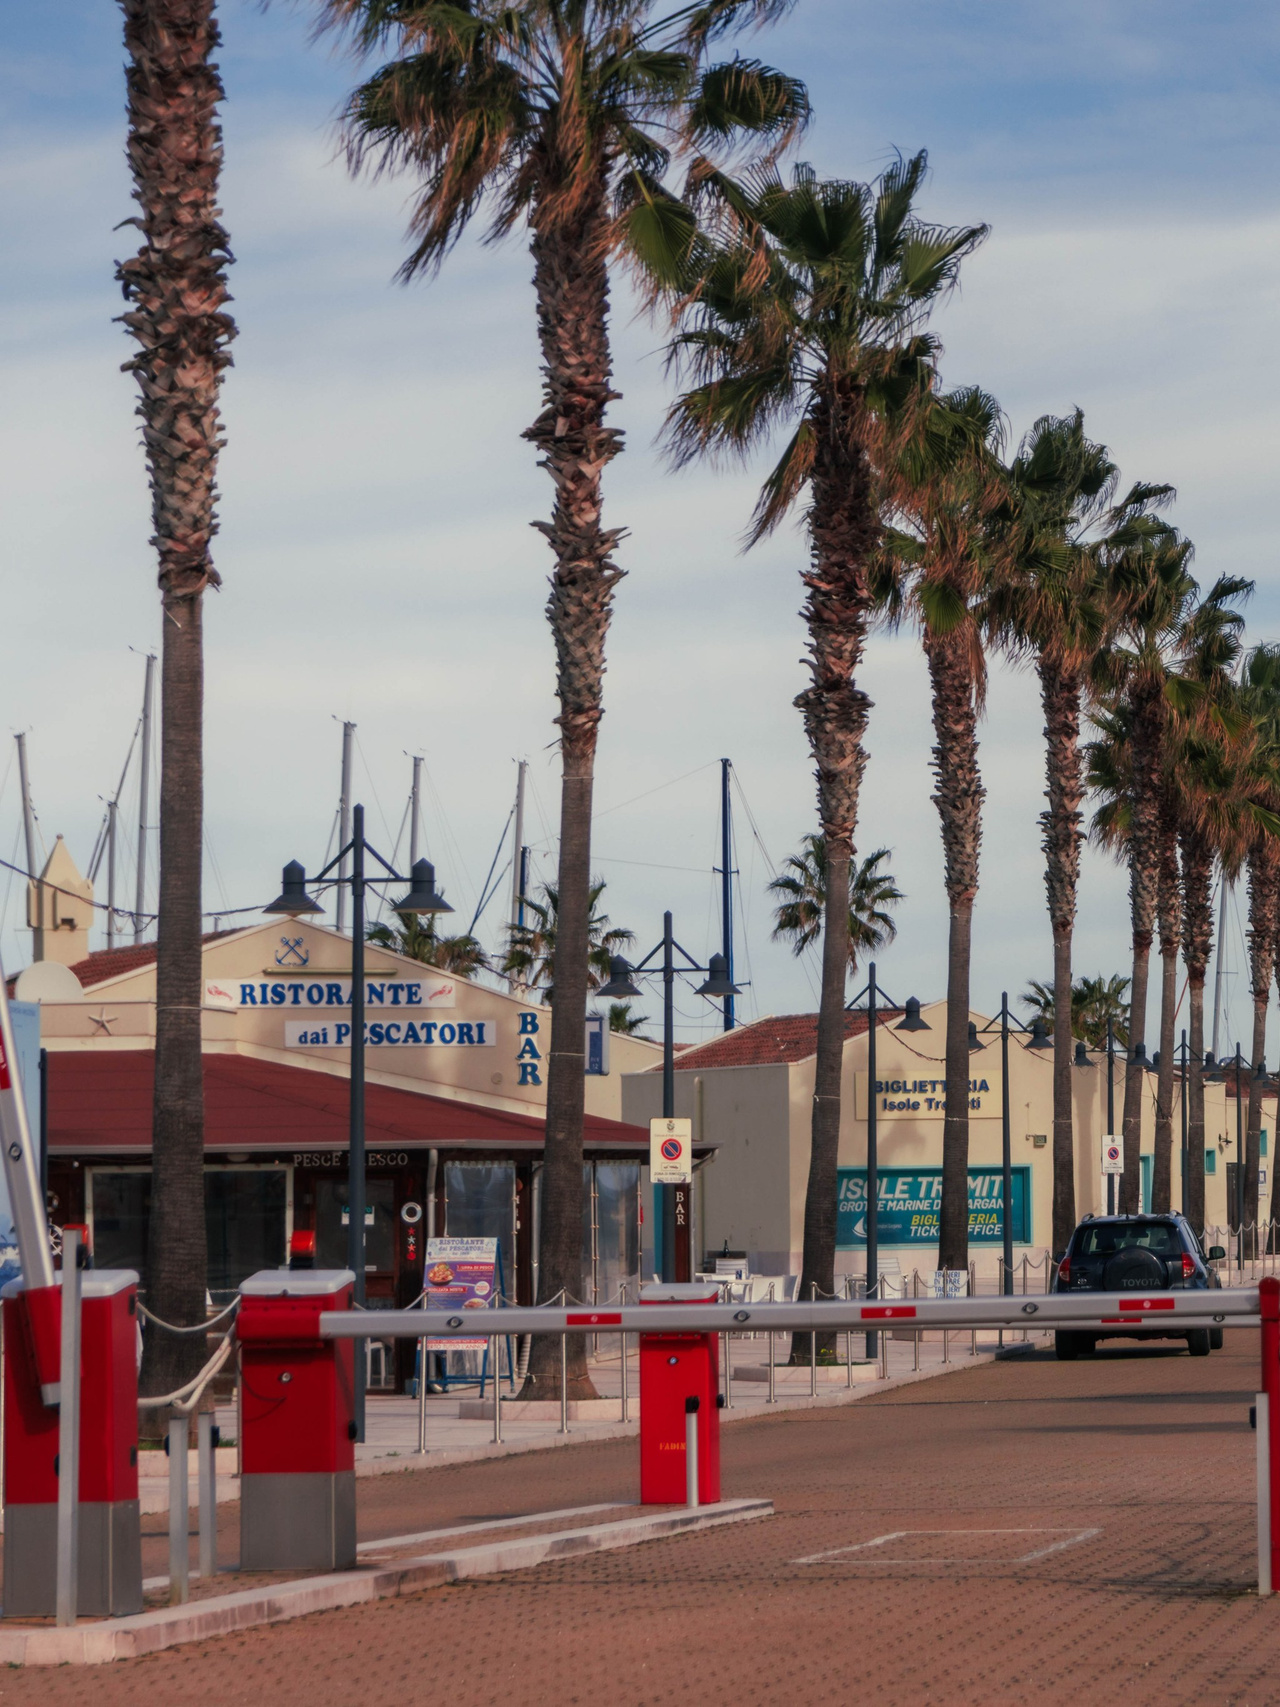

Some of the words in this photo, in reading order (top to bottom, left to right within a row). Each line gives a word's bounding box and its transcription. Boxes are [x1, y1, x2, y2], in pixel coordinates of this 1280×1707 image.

[240, 983, 422, 1005] RISTORNTE
[299, 1026, 329, 1045] dai
[516, 1012, 543, 1086] BAR
[883, 1098, 920, 1111] Isole
[294, 1152, 342, 1167] PESCE
[347, 1153, 408, 1166] ESCO
[675, 1191, 685, 1225] BAR
[886, 1200, 933, 1211] MARINE
[911, 1213, 998, 1226] BIGLERIA
[967, 1224, 1003, 1235] FFICE
[1121, 1278, 1161, 1287] TOYOTA
